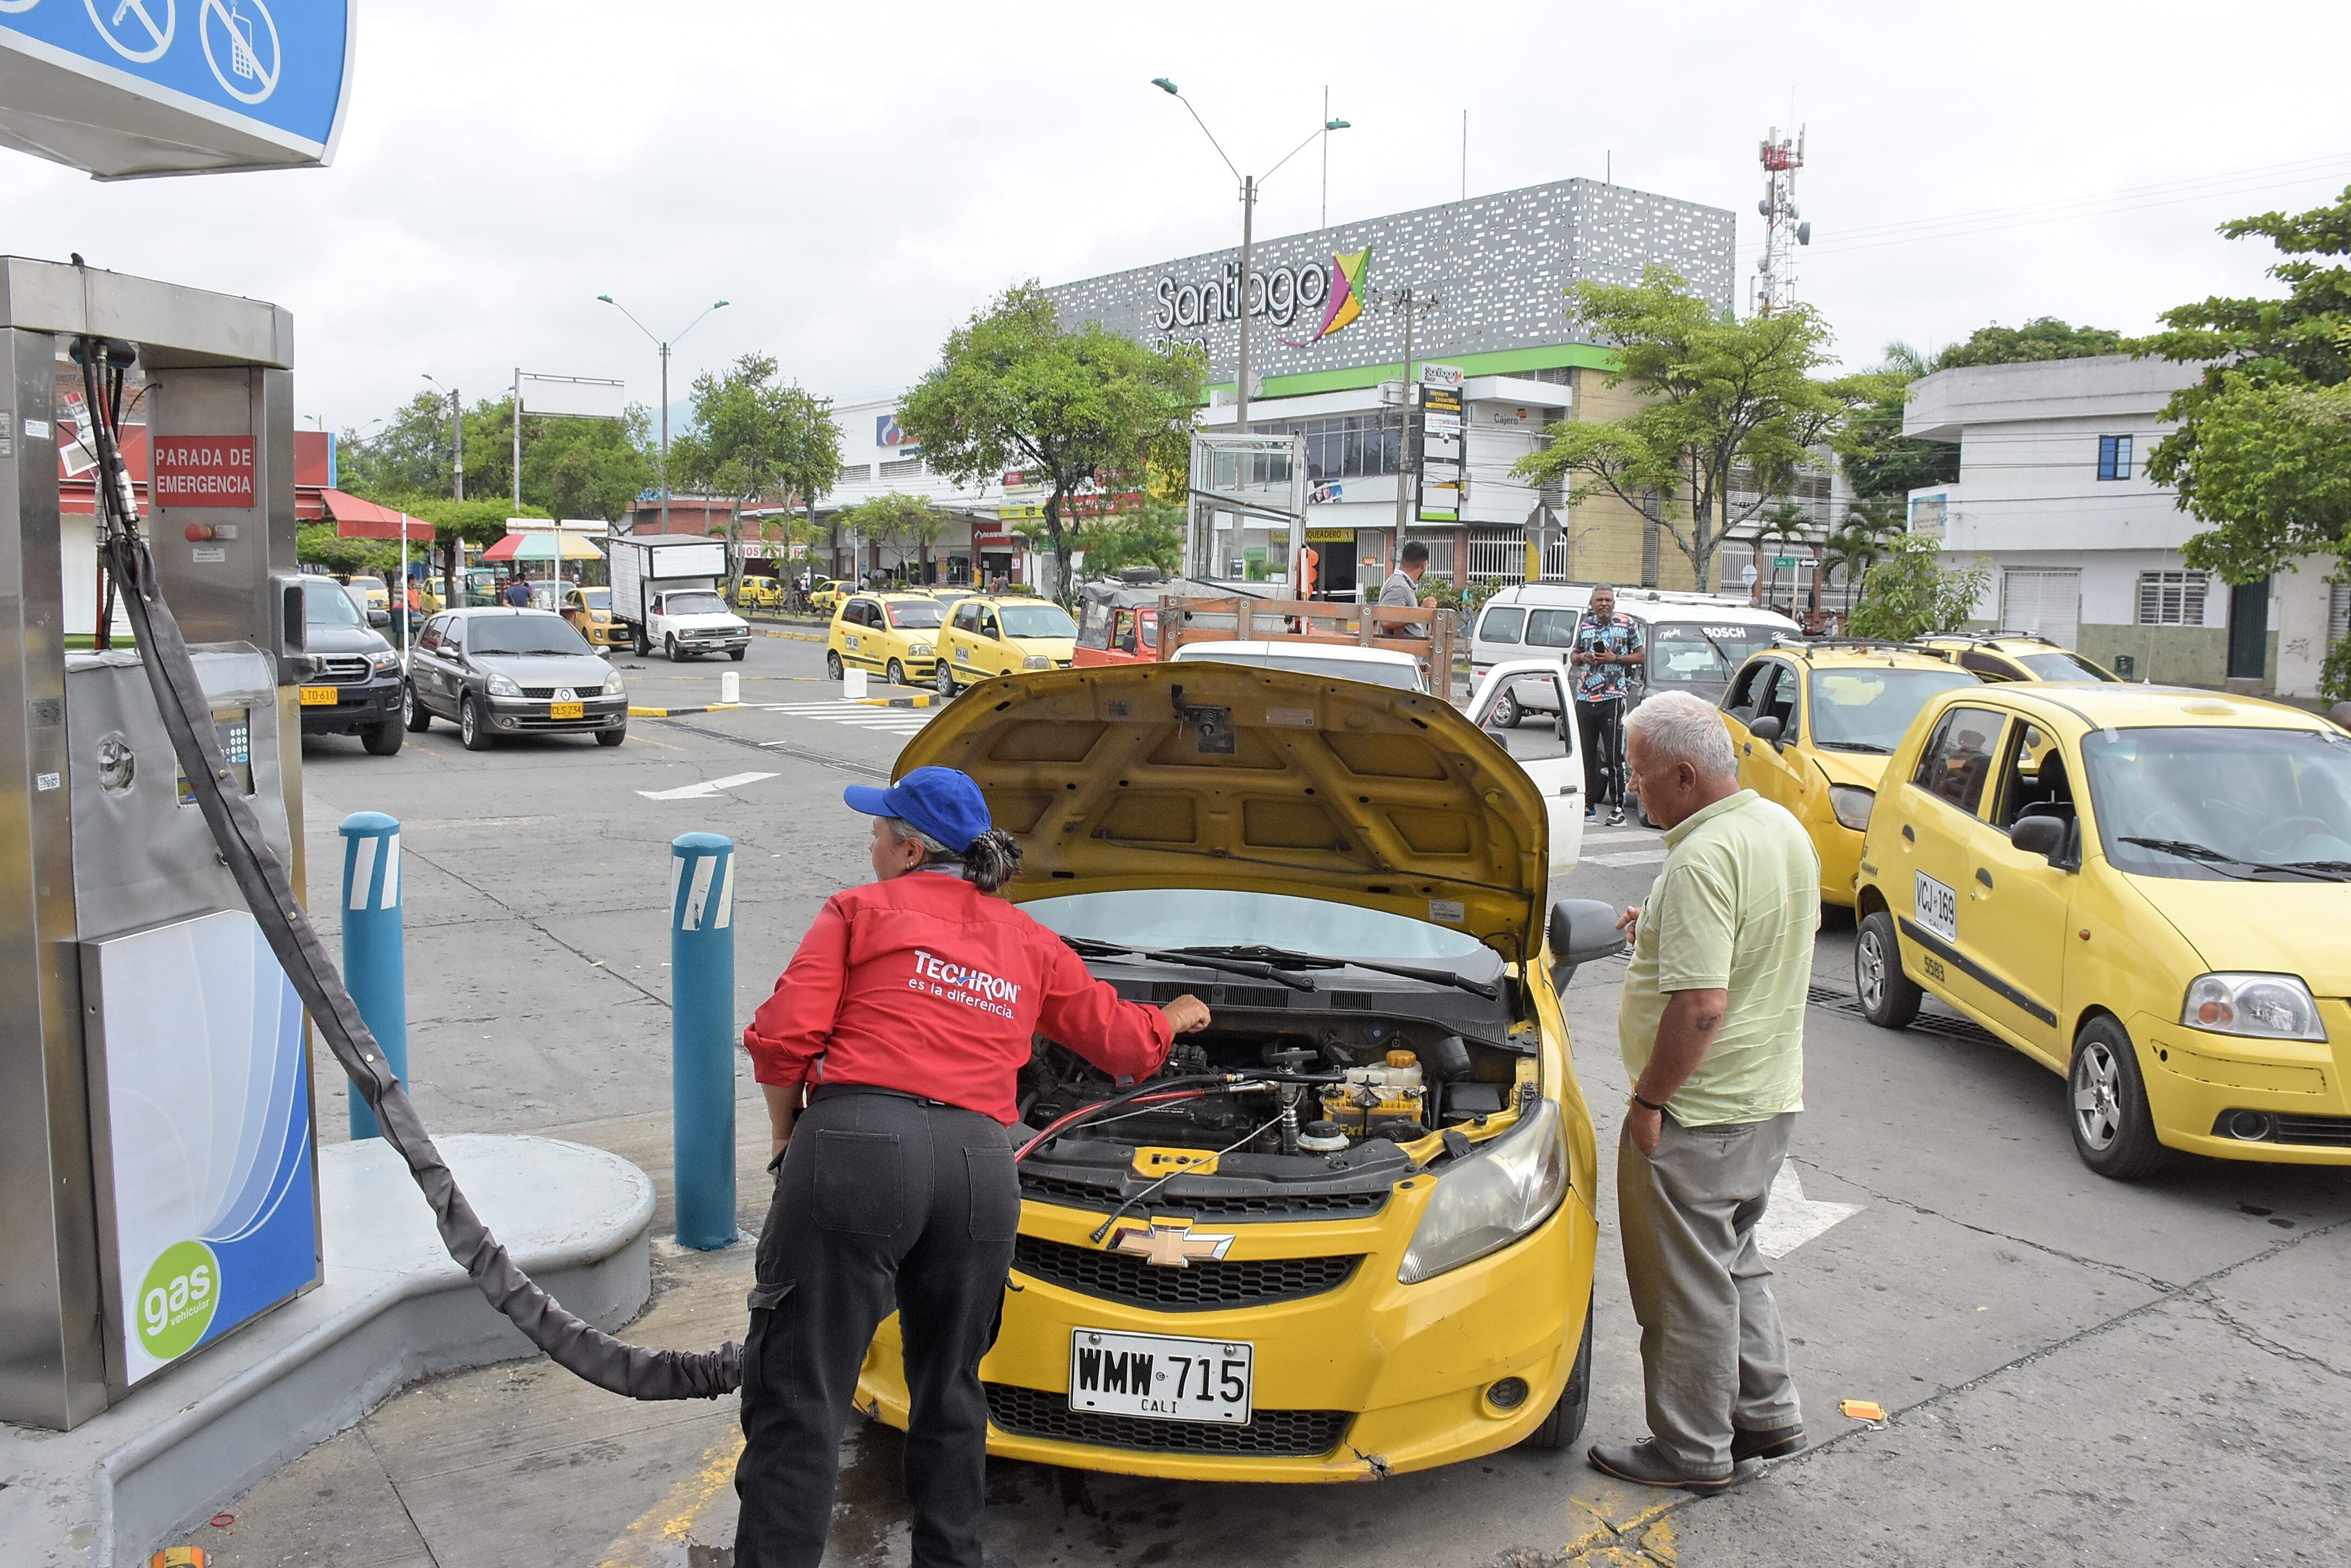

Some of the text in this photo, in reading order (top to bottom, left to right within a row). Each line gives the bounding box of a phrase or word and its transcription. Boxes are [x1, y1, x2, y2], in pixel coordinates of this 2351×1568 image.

[1154, 261, 1328, 330] Santiago
[1494, 413, 1518, 426] Cajero
[156, 448, 251, 466] PARADA DE
[157, 476, 251, 493] EMERGENCIA
[1609, 627, 1628, 638] VANS
[1703, 627, 1746, 638] BOSCH
[320, 691, 336, 700] 610
[552, 706, 581, 715] CLS 234
[1917, 877, 1955, 926] VCJ 169
[1929, 919, 1943, 931] CALI
[914, 950, 1018, 1004] TECHRON
[1924, 955, 1945, 982] 5583
[908, 978, 1014, 1020] es la diferencia.
[144, 1265, 211, 1336] gas
[170, 1299, 210, 1326] vehicular
[1079, 1347, 1246, 1402] WMW 715
[1141, 1398, 1178, 1413] CALI
